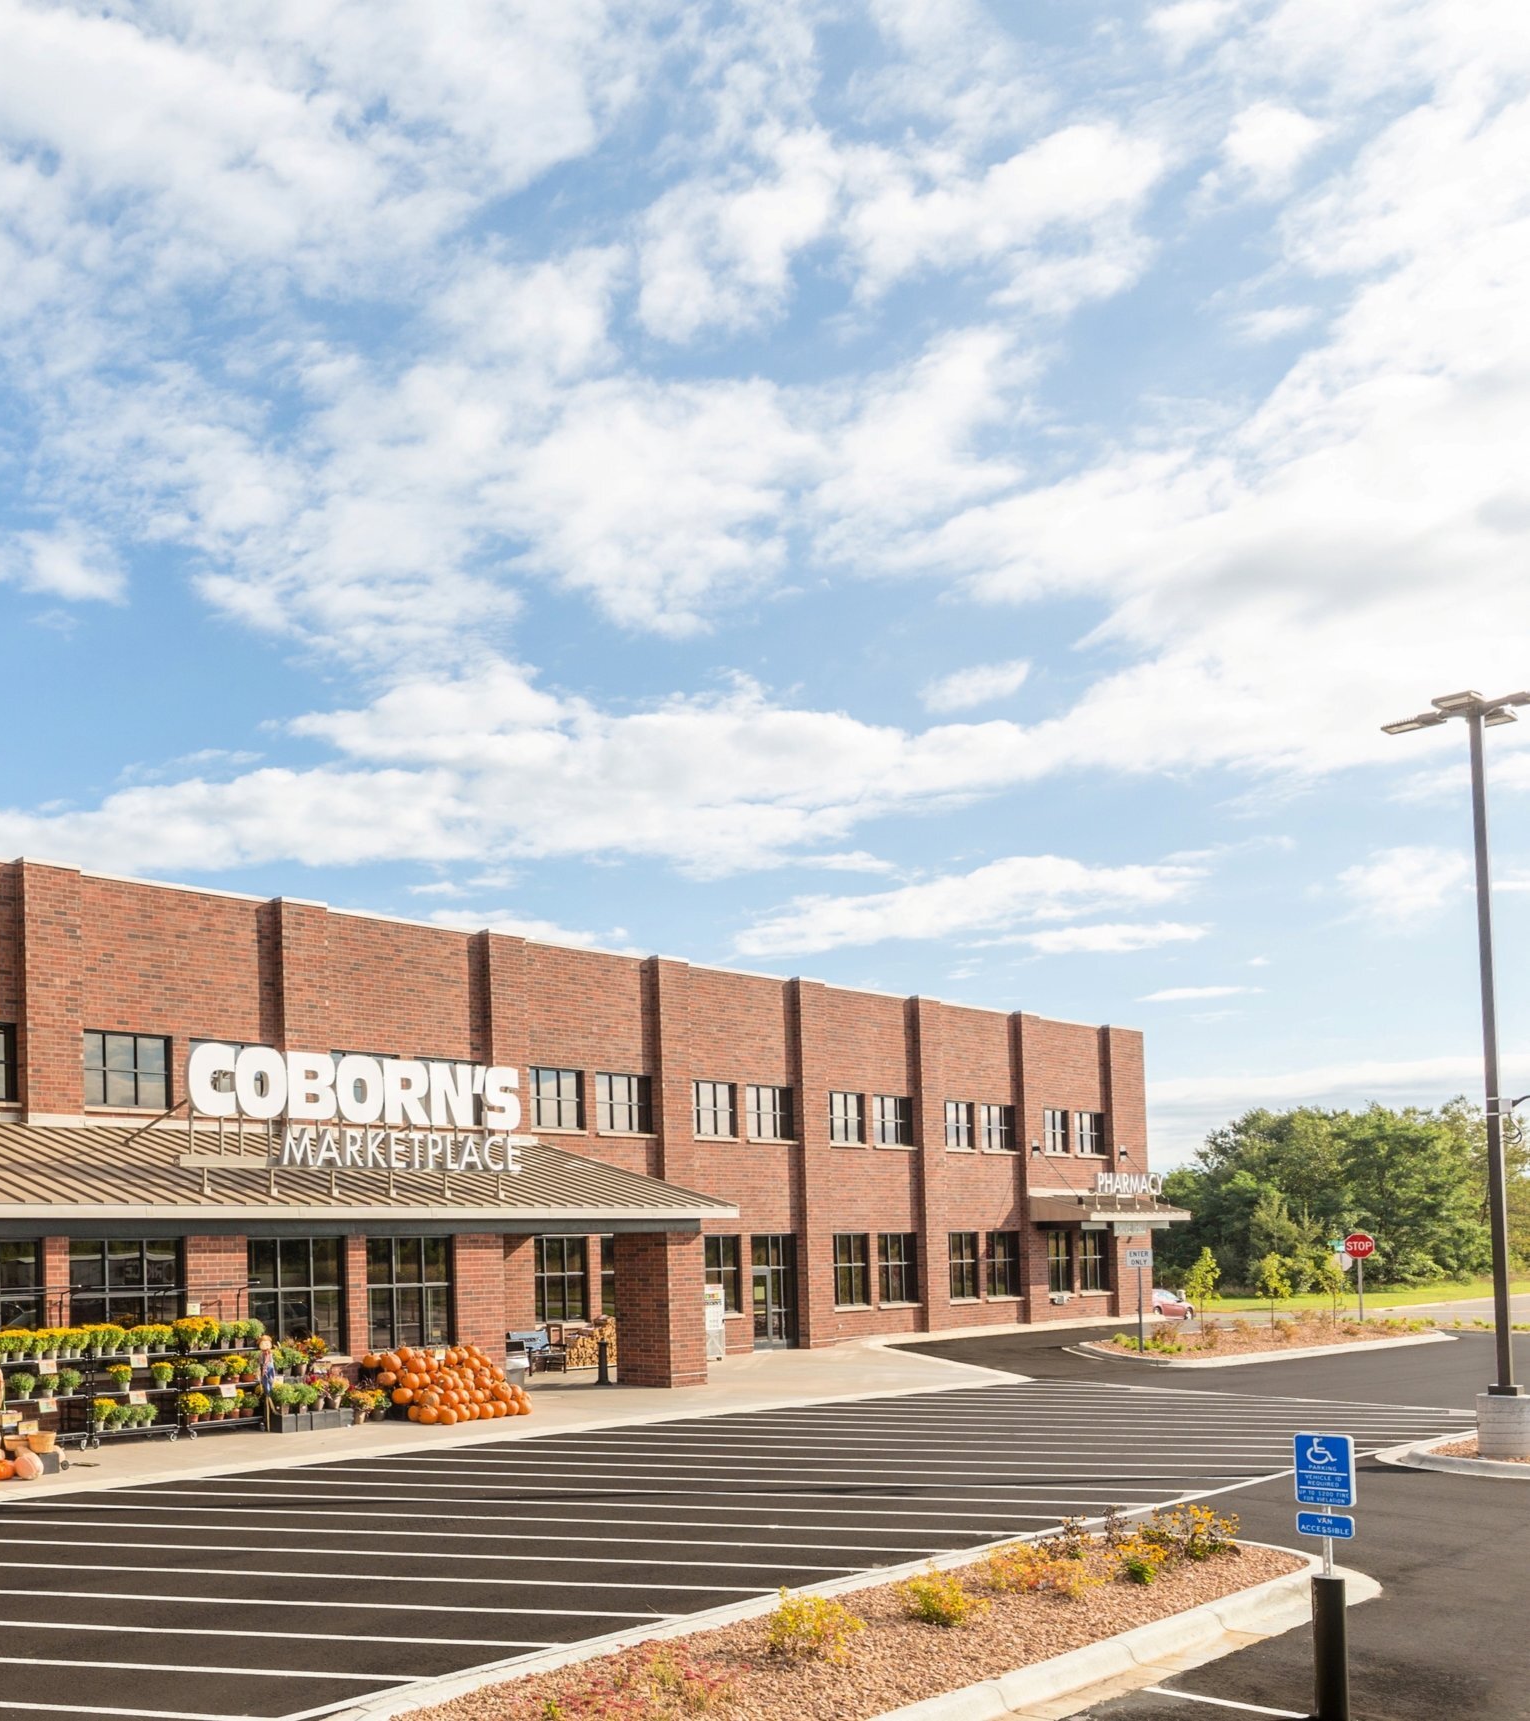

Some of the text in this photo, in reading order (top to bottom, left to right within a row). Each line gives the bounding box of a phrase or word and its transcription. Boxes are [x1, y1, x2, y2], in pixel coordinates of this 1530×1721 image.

[187, 1042, 522, 1131] COBORN'S
[281, 1126, 522, 1171] MARKETPLACE
[1096, 1172, 1163, 1195] PHARMACY
[1346, 1241, 1372, 1251] STOP
[1129, 1250, 1149, 1258] ENTER
[1317, 1517, 1333, 1525] VAN
[1301, 1524, 1350, 1535] ACCESSIBLE
